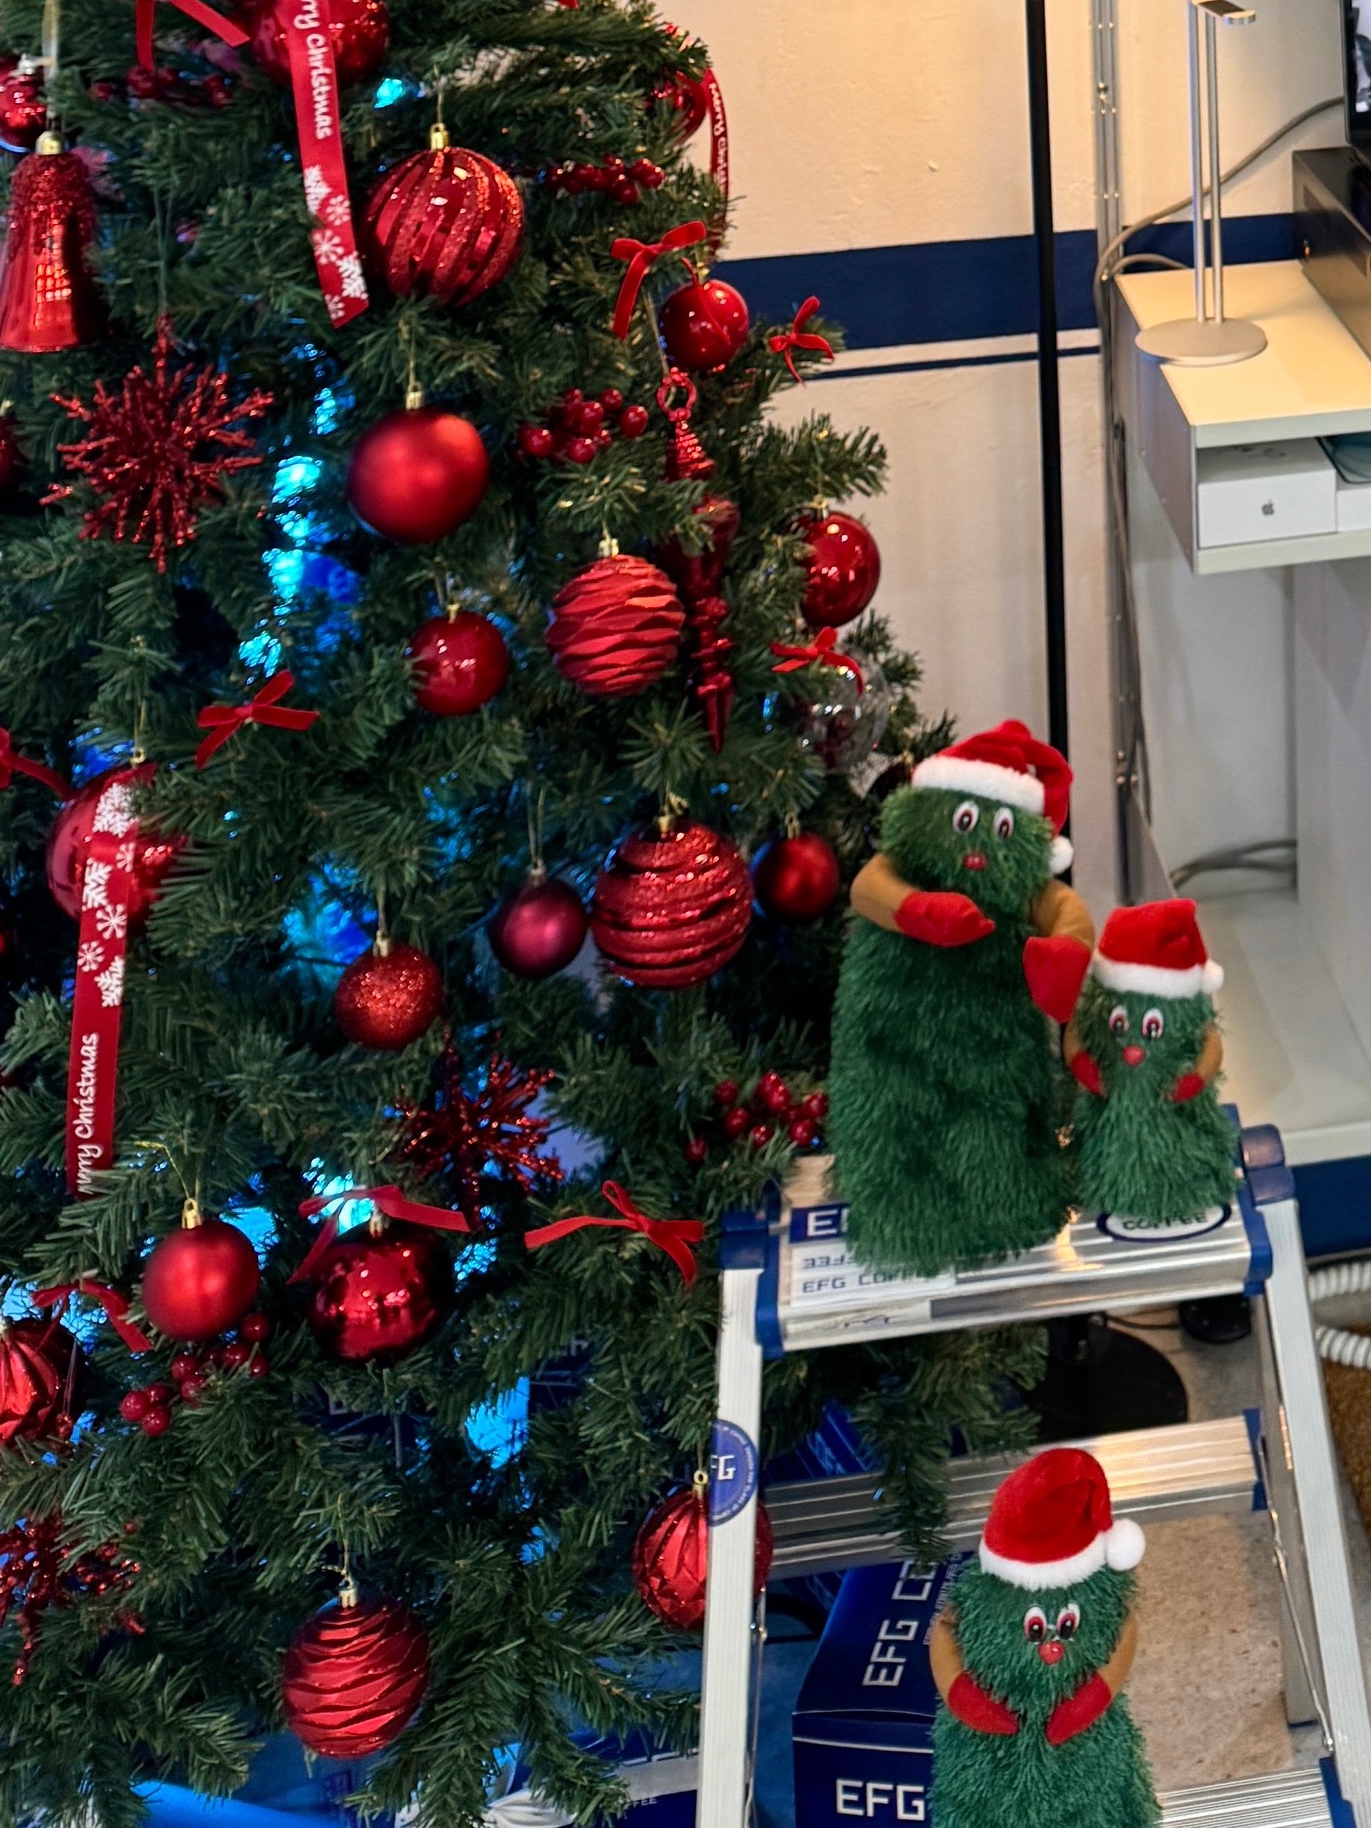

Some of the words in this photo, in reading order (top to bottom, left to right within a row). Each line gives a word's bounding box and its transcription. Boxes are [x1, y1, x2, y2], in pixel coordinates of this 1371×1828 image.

[72, 1032, 98, 1140] Christmas
[803, 1277, 846, 1293] EFG
[862, 1619, 919, 1686] EFG
[836, 1778, 925, 1821] EFG
